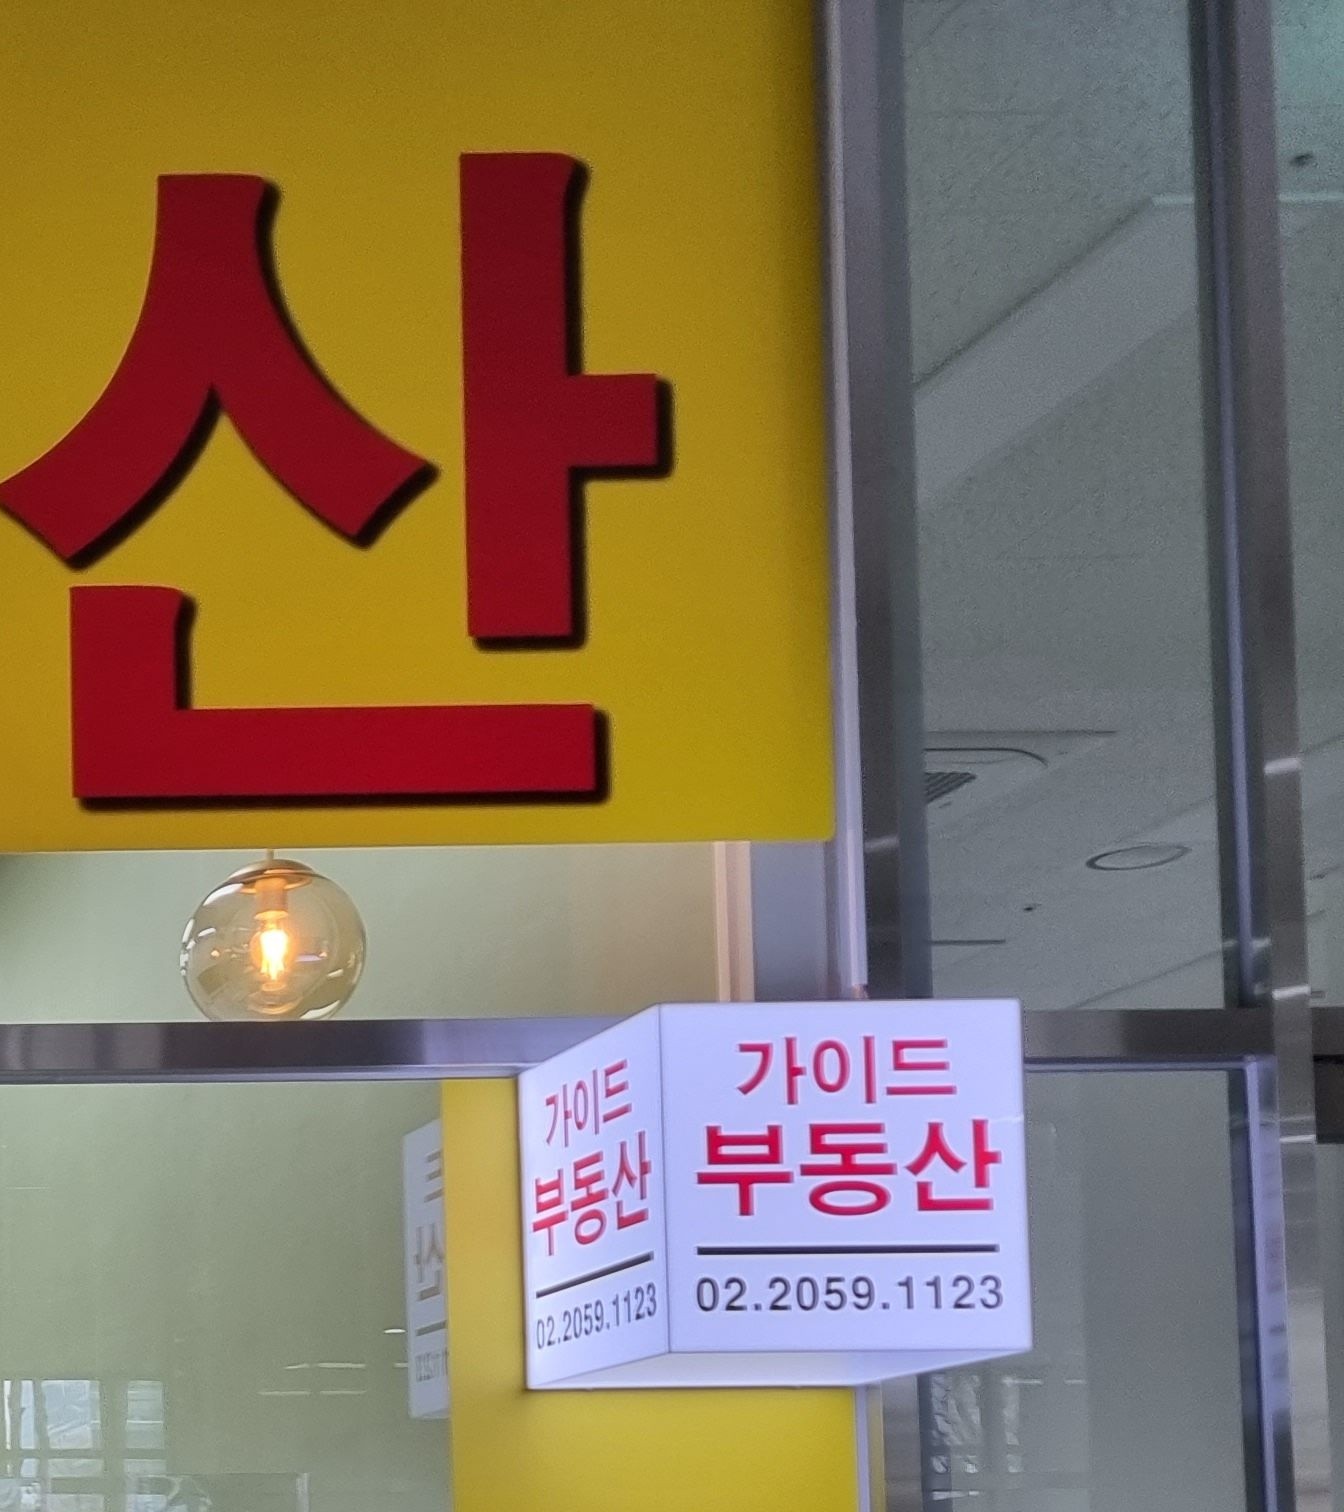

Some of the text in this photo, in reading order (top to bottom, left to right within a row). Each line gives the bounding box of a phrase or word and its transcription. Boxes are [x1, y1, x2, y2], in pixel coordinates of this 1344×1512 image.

[544, 1059, 633, 1149] 가이드
[737, 1035, 957, 1105] 가이드
[531, 1130, 653, 1257] 부동산
[696, 1117, 1002, 1217] 부동산
[535, 1282, 658, 1351] 02.2059.1123
[696, 1274, 1004, 1312] 02.2059.1123
